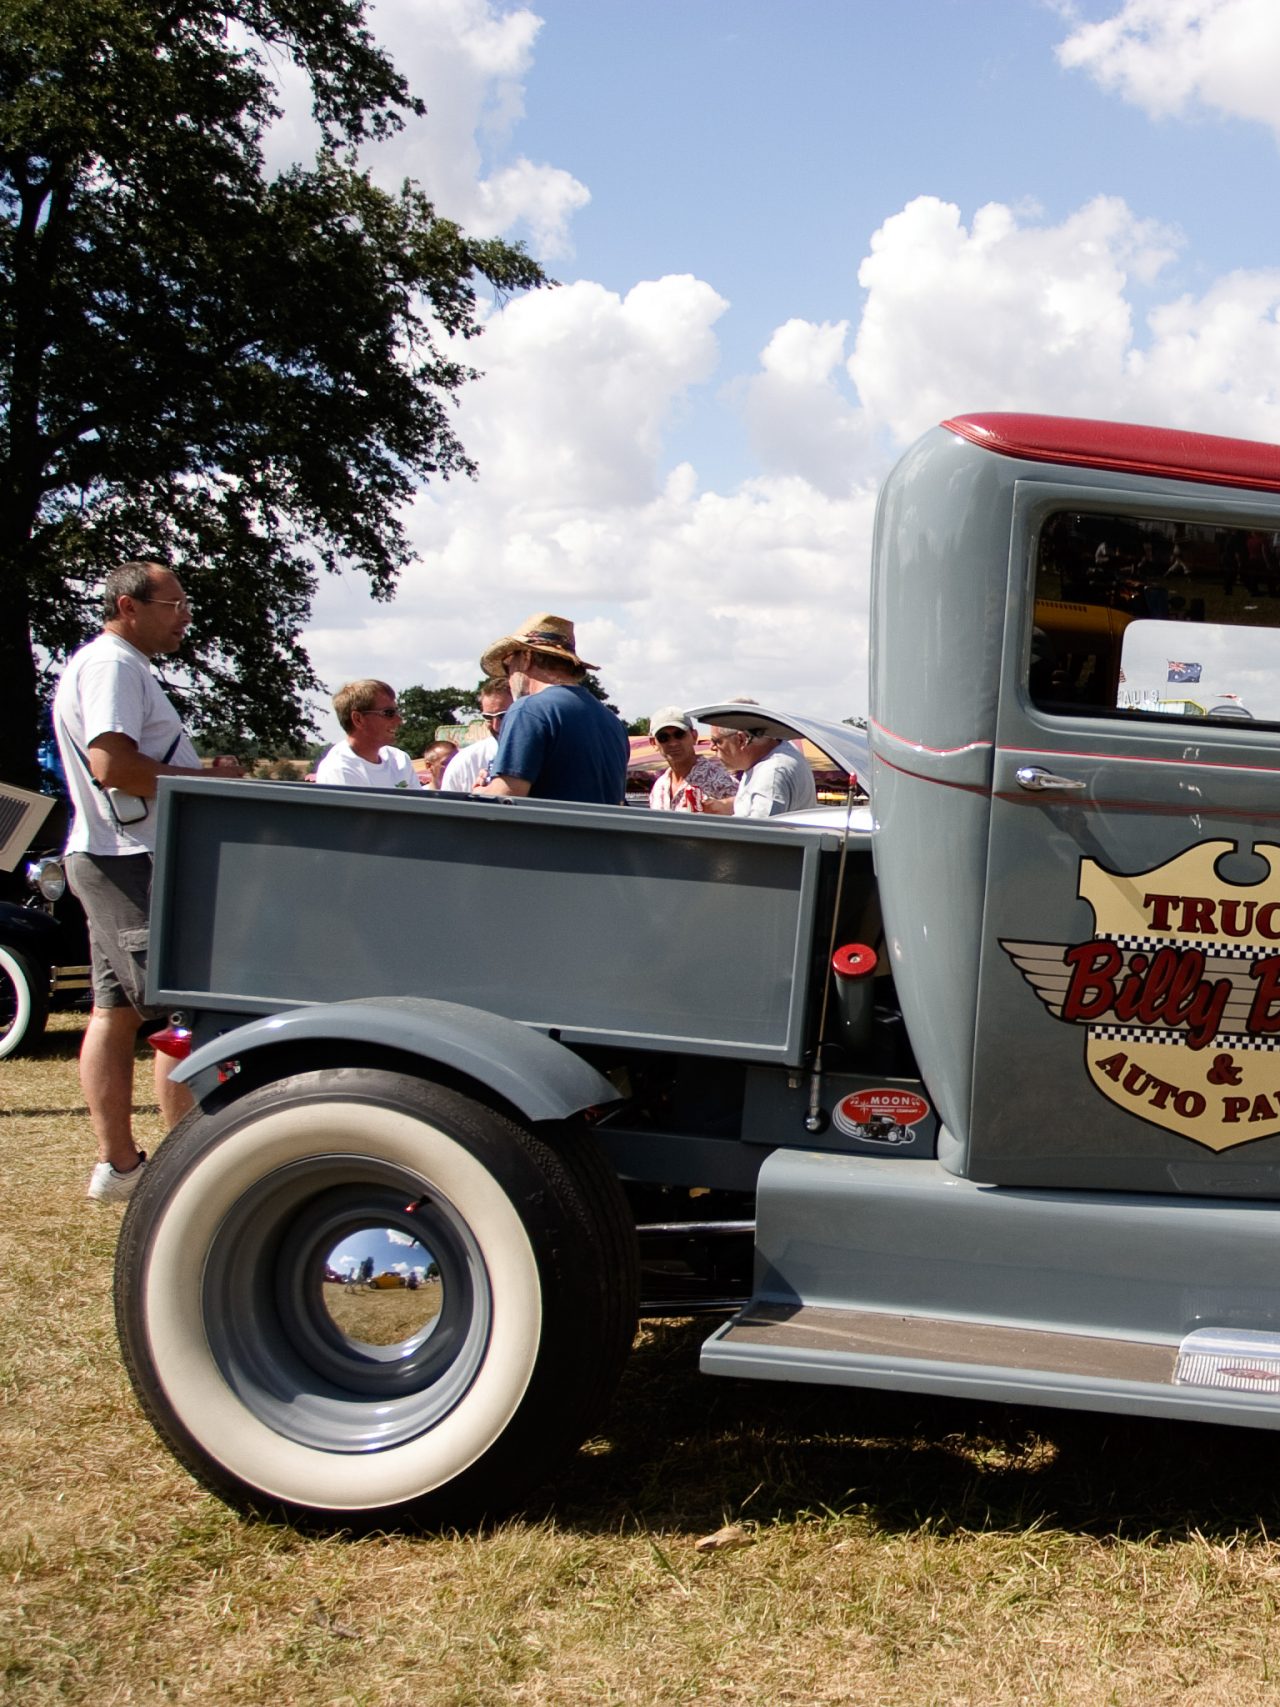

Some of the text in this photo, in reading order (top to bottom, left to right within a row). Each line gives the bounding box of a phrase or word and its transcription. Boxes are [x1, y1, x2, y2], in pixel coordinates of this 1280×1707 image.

[1061, 939, 1232, 1051] Billy
[1095, 1051, 1207, 1120] AUTO
[1206, 1053, 1243, 1086] &
[870, 1096, 909, 1105] MOON
